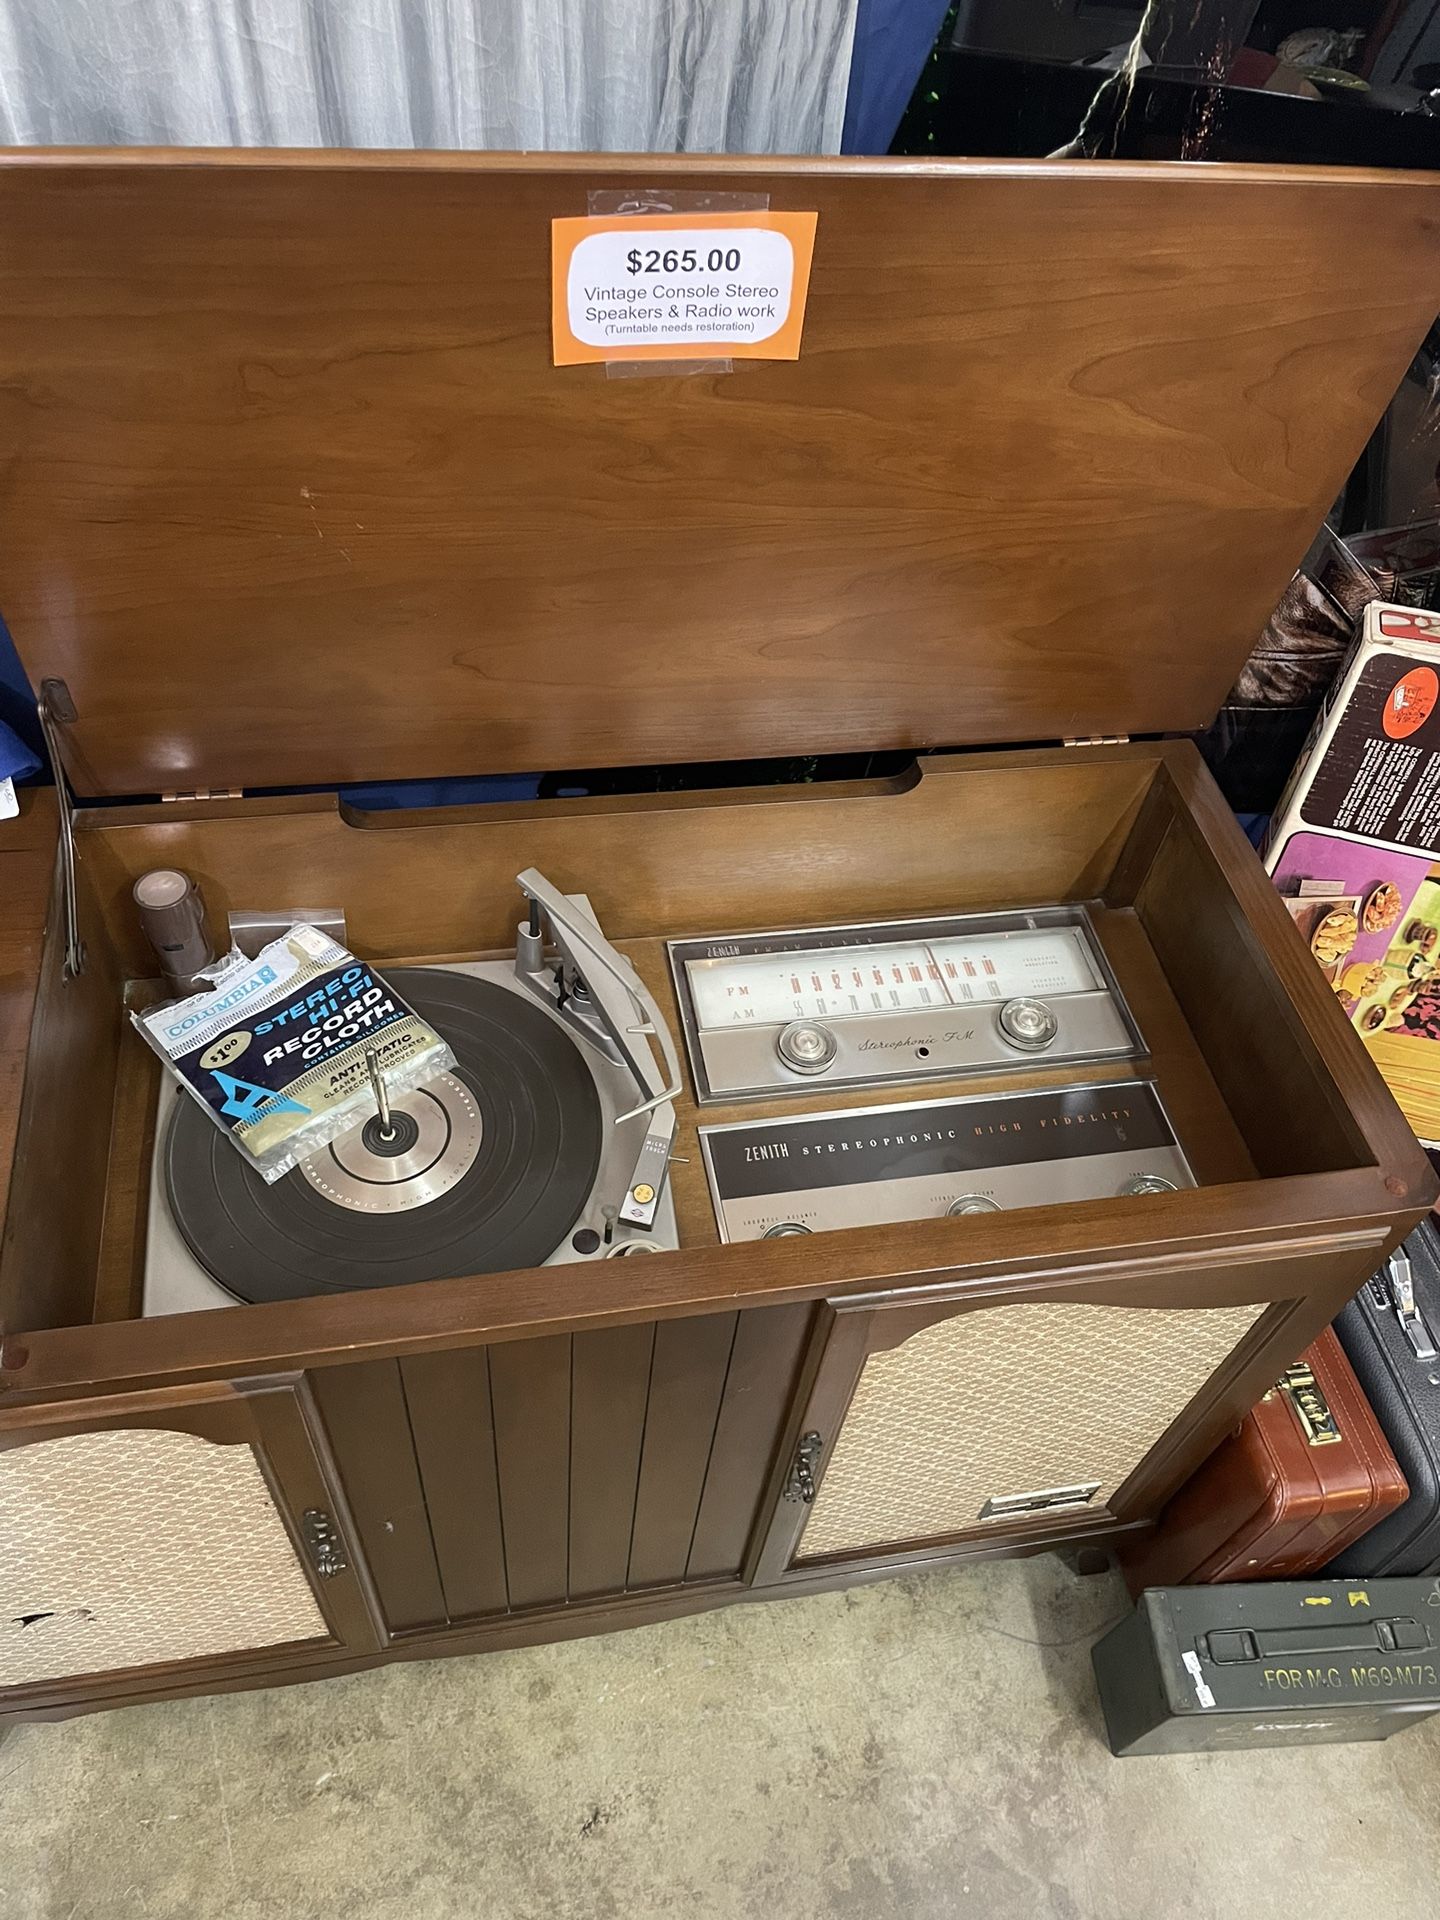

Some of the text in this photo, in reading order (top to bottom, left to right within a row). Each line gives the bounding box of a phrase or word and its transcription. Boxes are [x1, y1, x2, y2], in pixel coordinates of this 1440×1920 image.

[626, 248, 741, 276] $265.00
[583, 283, 779, 303] Vintage Console Stereo
[585, 303, 776, 324] Speakers & Radio work
[604, 321, 755, 336] (Turntable needs restoration)
[706, 945, 740, 958] ZENITH
[726, 985, 749, 997] FM
[831, 973, 843, 990] 92
[169, 979, 263, 1037] COLUMBIA
[254, 967, 362, 1036] STEREO
[733, 1008, 755, 1020] AM
[262, 987, 384, 1067] RECORD
[301, 1000, 395, 1061] CLOTH
[303, 1011, 405, 1069] CONTAINS SILICONES
[857, 1035, 936, 1053] Stereophonic
[323, 1077, 357, 1099] CLEANS
[379, 1036, 427, 1064] LUBRICATES
[330, 1034, 412, 1087] ANTI-TATIC
[343, 1072, 372, 1096] RECOR
[744, 1108, 1132, 1164] ZENITH STEREOPHONIC HIGH FIDELITY
[304, 1157, 378, 1209] TEREOPHONIC
[1264, 1668, 1303, 1690] FOR
